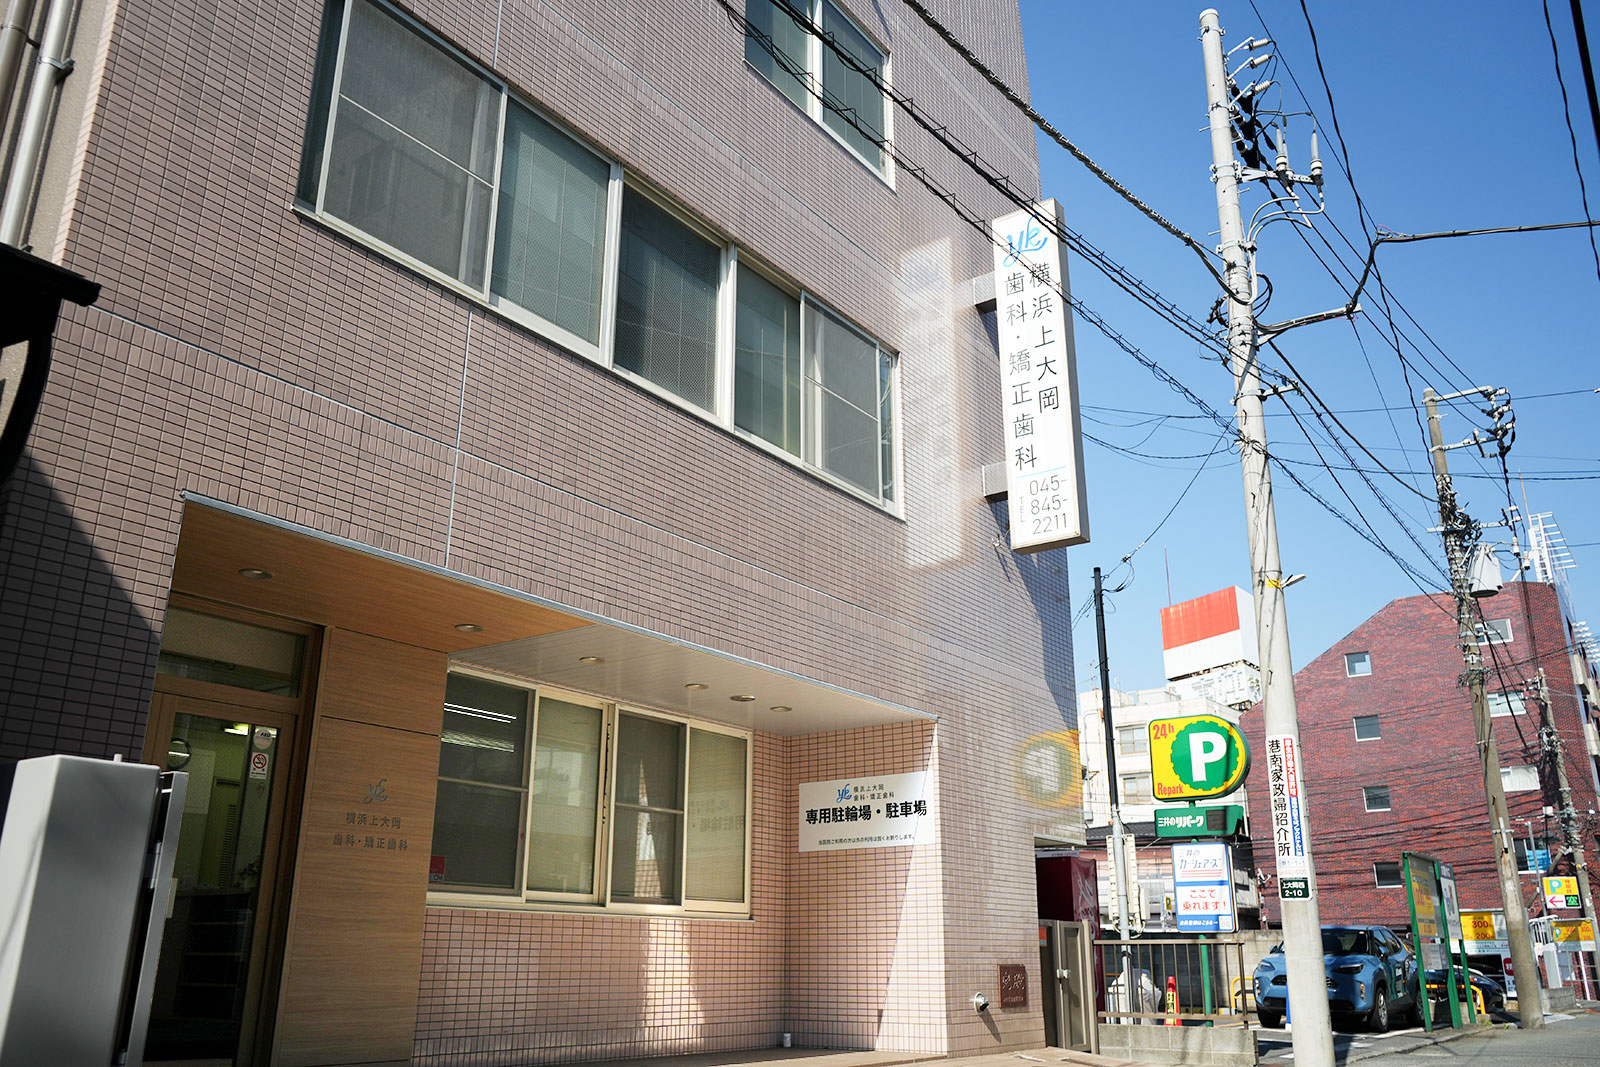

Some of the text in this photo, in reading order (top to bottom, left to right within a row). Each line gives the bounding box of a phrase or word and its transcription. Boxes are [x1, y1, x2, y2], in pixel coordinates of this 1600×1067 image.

[1030, 262, 1060, 414] 横浜上大岡
[1004, 271, 1037, 471] 歯科・矯正歯科
[1032, 513, 1067, 535] 2211
[1152, 723, 1175, 740] 24h
[1188, 731, 1227, 782] P
[853, 784, 884, 794] 横浜上大岡
[1157, 782, 1184, 797] Repark
[1268, 739, 1291, 857] 港南家政婦紹介所
[345, 811, 402, 829] 横浜上大岡
[805, 800, 927, 825] 専用駐輪場・駐車場
[1157, 815, 1205, 828] 三井のリパーク
[1284, 889, 1303, 897] 2-10
[1566, 896, 1579, 906] 空
